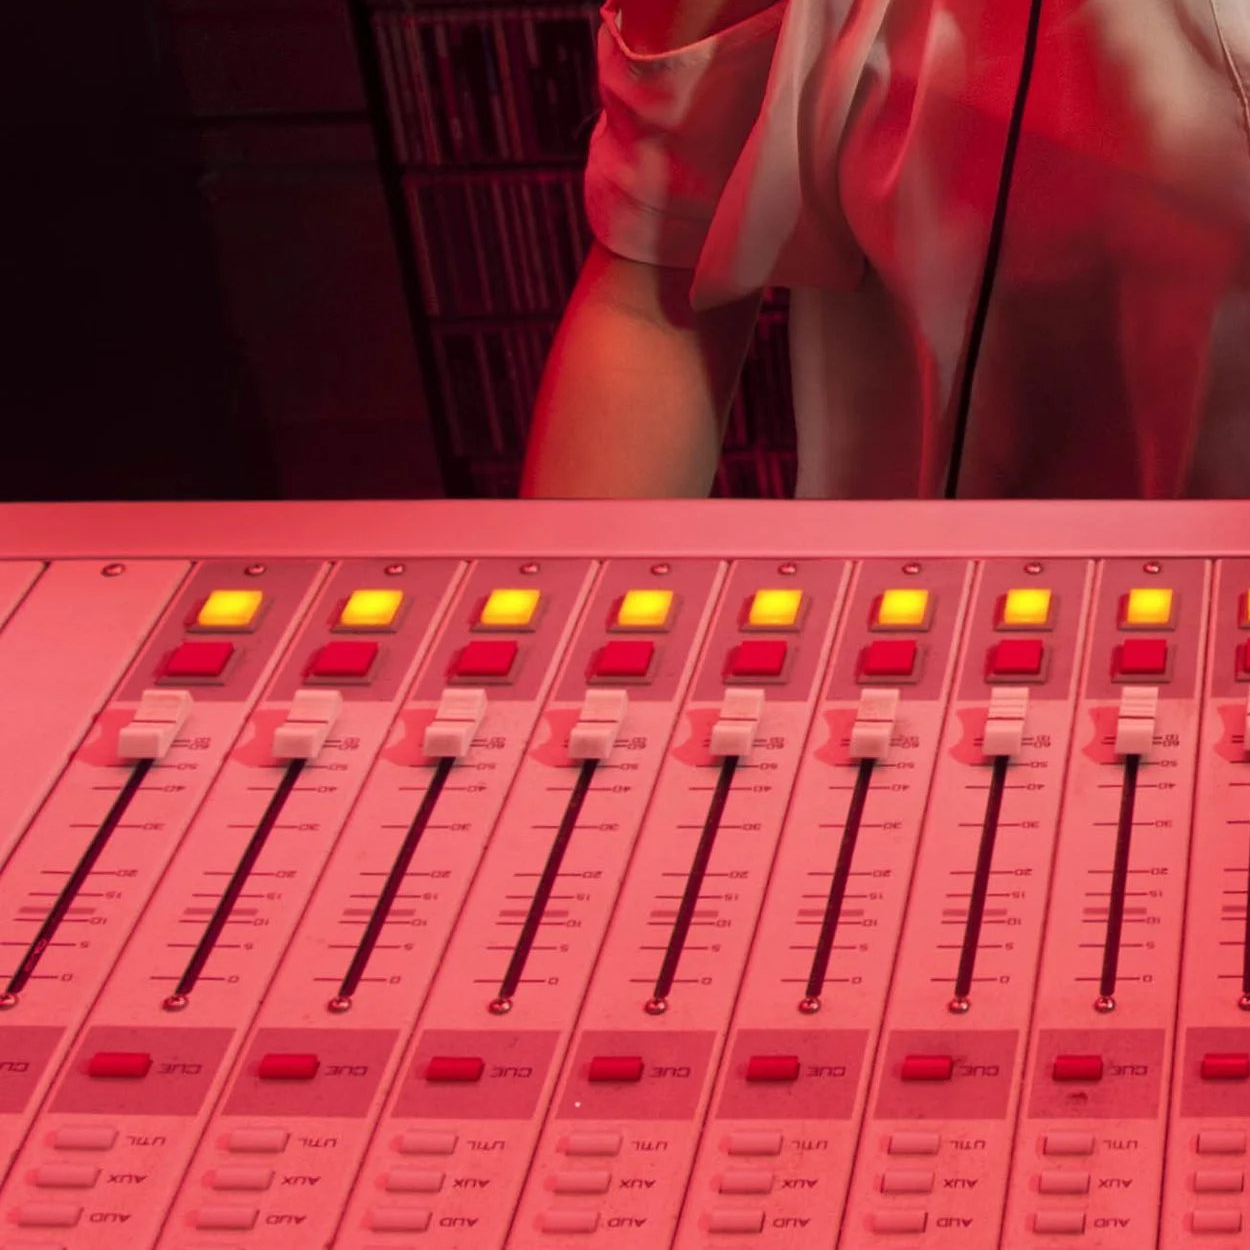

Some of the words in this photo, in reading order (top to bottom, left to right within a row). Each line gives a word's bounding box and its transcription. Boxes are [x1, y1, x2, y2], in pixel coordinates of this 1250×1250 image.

[0, 1062, 30, 1073] CU
[156, 1063, 202, 1075] CUE
[325, 1065, 368, 1076] CUE
[490, 1067, 533, 1078] CUE
[649, 1067, 691, 1078] CUE
[807, 1066, 846, 1077] CUE
[959, 1065, 999, 1077] CUE
[1112, 1065, 1148, 1076] CUE
[126, 1136, 166, 1146] UTIL
[299, 1138, 337, 1148] UTIL
[468, 1141, 505, 1151] UTIL
[633, 1141, 668, 1151] UTIL
[792, 1140, 828, 1151] UTIL
[950, 1140, 986, 1150] UTIL
[1103, 1140, 1138, 1150] UTIL
[107, 1174, 148, 1184] AUX
[281, 1176, 321, 1186] AUX
[453, 1179, 490, 1188] AUX
[619, 1179, 656, 1188] AUX
[782, 1179, 818, 1189] AUX
[944, 1178, 978, 1188] AUX
[1098, 1178, 1132, 1188] AUX
[89, 1213, 131, 1223] AUD
[266, 1215, 307, 1225] AUD
[439, 1217, 479, 1227] AUD
[607, 1218, 646, 1227] AUD
[772, 1218, 810, 1228] AUD
[936, 1217, 973, 1228] AUD
[1093, 1218, 1130, 1228] AUD
